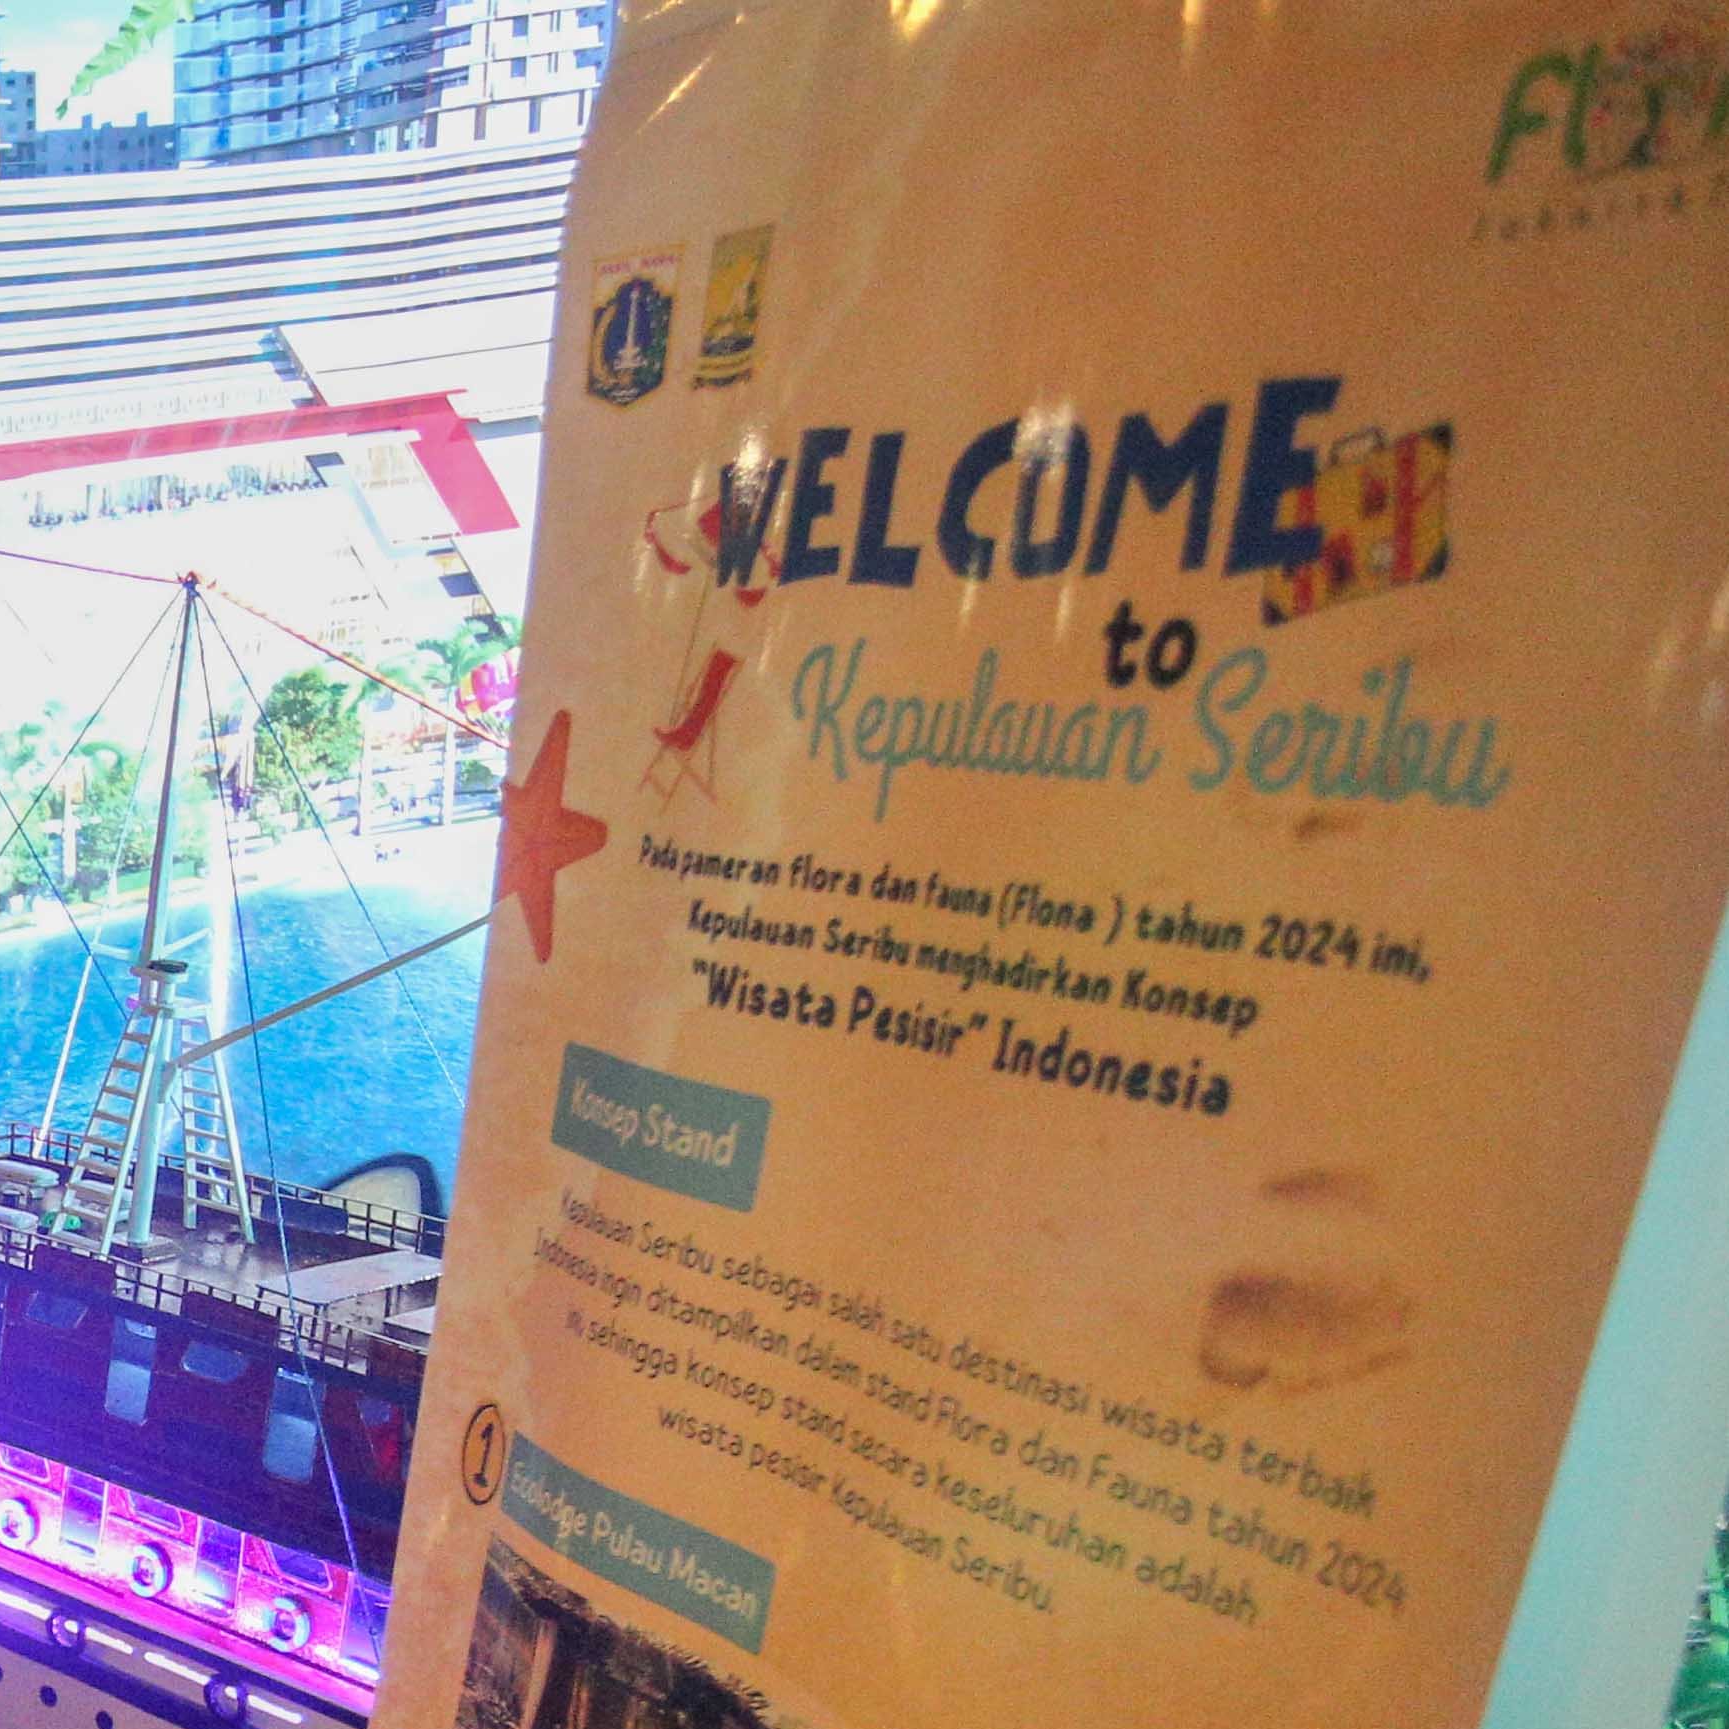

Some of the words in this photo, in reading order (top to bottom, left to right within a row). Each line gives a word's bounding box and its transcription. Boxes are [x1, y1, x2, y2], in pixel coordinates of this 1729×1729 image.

[715, 377, 1343, 588] WELCOME
[1106, 601, 1198, 691] to
[791, 637, 1166, 824] Kepulauan
[1188, 649, 1514, 809] Seribu
[680, 848, 780, 885] pameran
[789, 853, 862, 897] flora
[870, 863, 917, 904] dan
[923, 873, 992, 917] fauna
[1134, 901, 1247, 953] tahun
[1254, 913, 1360, 970] 2024
[687, 897, 815, 950] Kepulauan
[822, 918, 910, 967] Seribu
[915, 944, 1111, 1006] menghadirkan
[1120, 966, 1261, 1040] Konsep
[991, 1016, 1233, 1116] Indonesia
[643, 1103, 737, 1168] Stand
[638, 1220, 715, 1276] Seribu
[720, 1251, 823, 1312] sebagai
[827, 1291, 885, 1334] salah
[890, 1317, 941, 1363] satu
[949, 1336, 1089, 1415] destinasi
[1100, 1398, 1227, 1462] wisata
[1240, 1436, 1376, 1519] terbaik
[471, 1422, 495, 1488] 1
[586, 1319, 677, 1378] sehingga
[685, 1346, 775, 1416] konsep
[781, 1394, 845, 1444] stand
[849, 1426, 927, 1488] secara
[936, 1459, 1127, 1569] keseluruhan
[1134, 1553, 1259, 1626] adalah
[647, 1282, 790, 1358] ditampilkan
[794, 1335, 861, 1387] dalam
[865, 1371, 934, 1422] stand
[936, 1394, 1010, 1456] Flora
[1017, 1429, 1080, 1481] dan
[1088, 1453, 1193, 1526] Fauna
[1207, 1502, 1309, 1573] tahun
[1315, 1539, 1407, 1610] 2024
[657, 1406, 743, 1457] wisata
[748, 1442, 827, 1494] pesisir
[591, 1511, 662, 1575] Pulau
[668, 1545, 759, 1620] Macan
